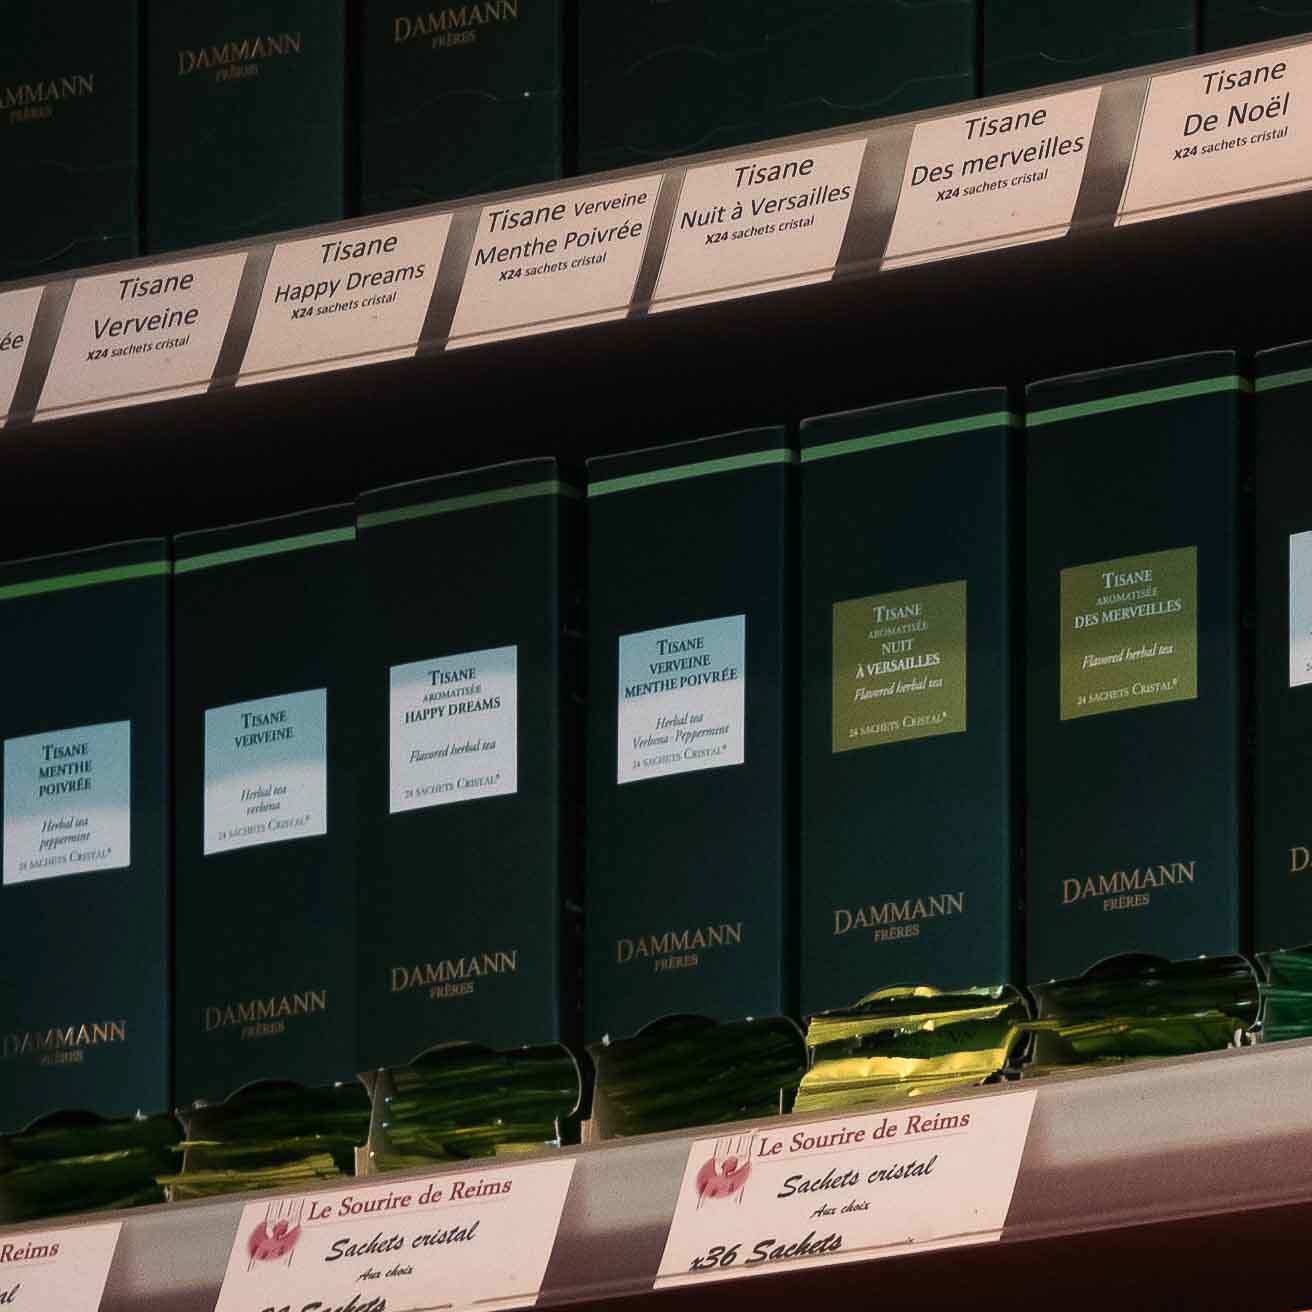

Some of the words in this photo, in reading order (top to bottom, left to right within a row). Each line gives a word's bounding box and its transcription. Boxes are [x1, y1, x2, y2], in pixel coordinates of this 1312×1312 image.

[1202, 62, 1287, 95] Tisane
[965, 108, 1048, 140] Tisane
[1183, 113, 1219, 136] De
[1227, 93, 1289, 126] Noël
[734, 157, 814, 188] Tisane
[910, 162, 955, 187] Des
[960, 135, 1084, 177] merveilles
[936, 188, 959, 201] X24
[962, 180, 1008, 197] sachets
[1011, 170, 1048, 186] cristal
[488, 202, 565, 233] Tisane
[573, 190, 647, 215] Verveine
[679, 207, 726, 230] Nuit
[731, 203, 742, 220] à
[750, 182, 851, 217] Versailles
[320, 233, 398, 264] Tisane
[473, 239, 558, 267] Menthe
[563, 220, 643, 252] Poivrée
[119, 272, 195, 299] Tisane
[273, 279, 341, 306] Happy
[346, 260, 425, 291] Dreams
[93, 305, 199, 340] Verveine
[1102, 569, 1153, 589] TISANE
[1074, 612, 1098, 629] DES
[1101, 599, 1182, 624] MERVEILLES
[428, 667, 476, 686] TISANE
[405, 702, 446, 724] HAPPY
[449, 696, 501, 715] DREAMS
[758, 1137, 783, 1158] Le
[787, 1128, 865, 1153] Sourire
[872, 1122, 898, 1140] de
[905, 1111, 969, 1135] Reims
[777, 1171, 860, 1198] Sachets
[867, 1155, 937, 1184] cristal
[307, 1199, 334, 1222] Le
[339, 1191, 411, 1218] Sourire
[416, 1186, 442, 1204] de
[449, 1177, 512, 1201] Reims
[810, 1205, 837, 1218] Aux
[840, 1200, 870, 1214] choix
[324, 1232, 405, 1261] Sachets
[411, 1221, 479, 1249] cristal
[689, 1245, 741, 1273] x36
[744, 1232, 842, 1267] Sachets
[356, 1269, 382, 1282] Aux
[384, 1264, 413, 1279] choix
